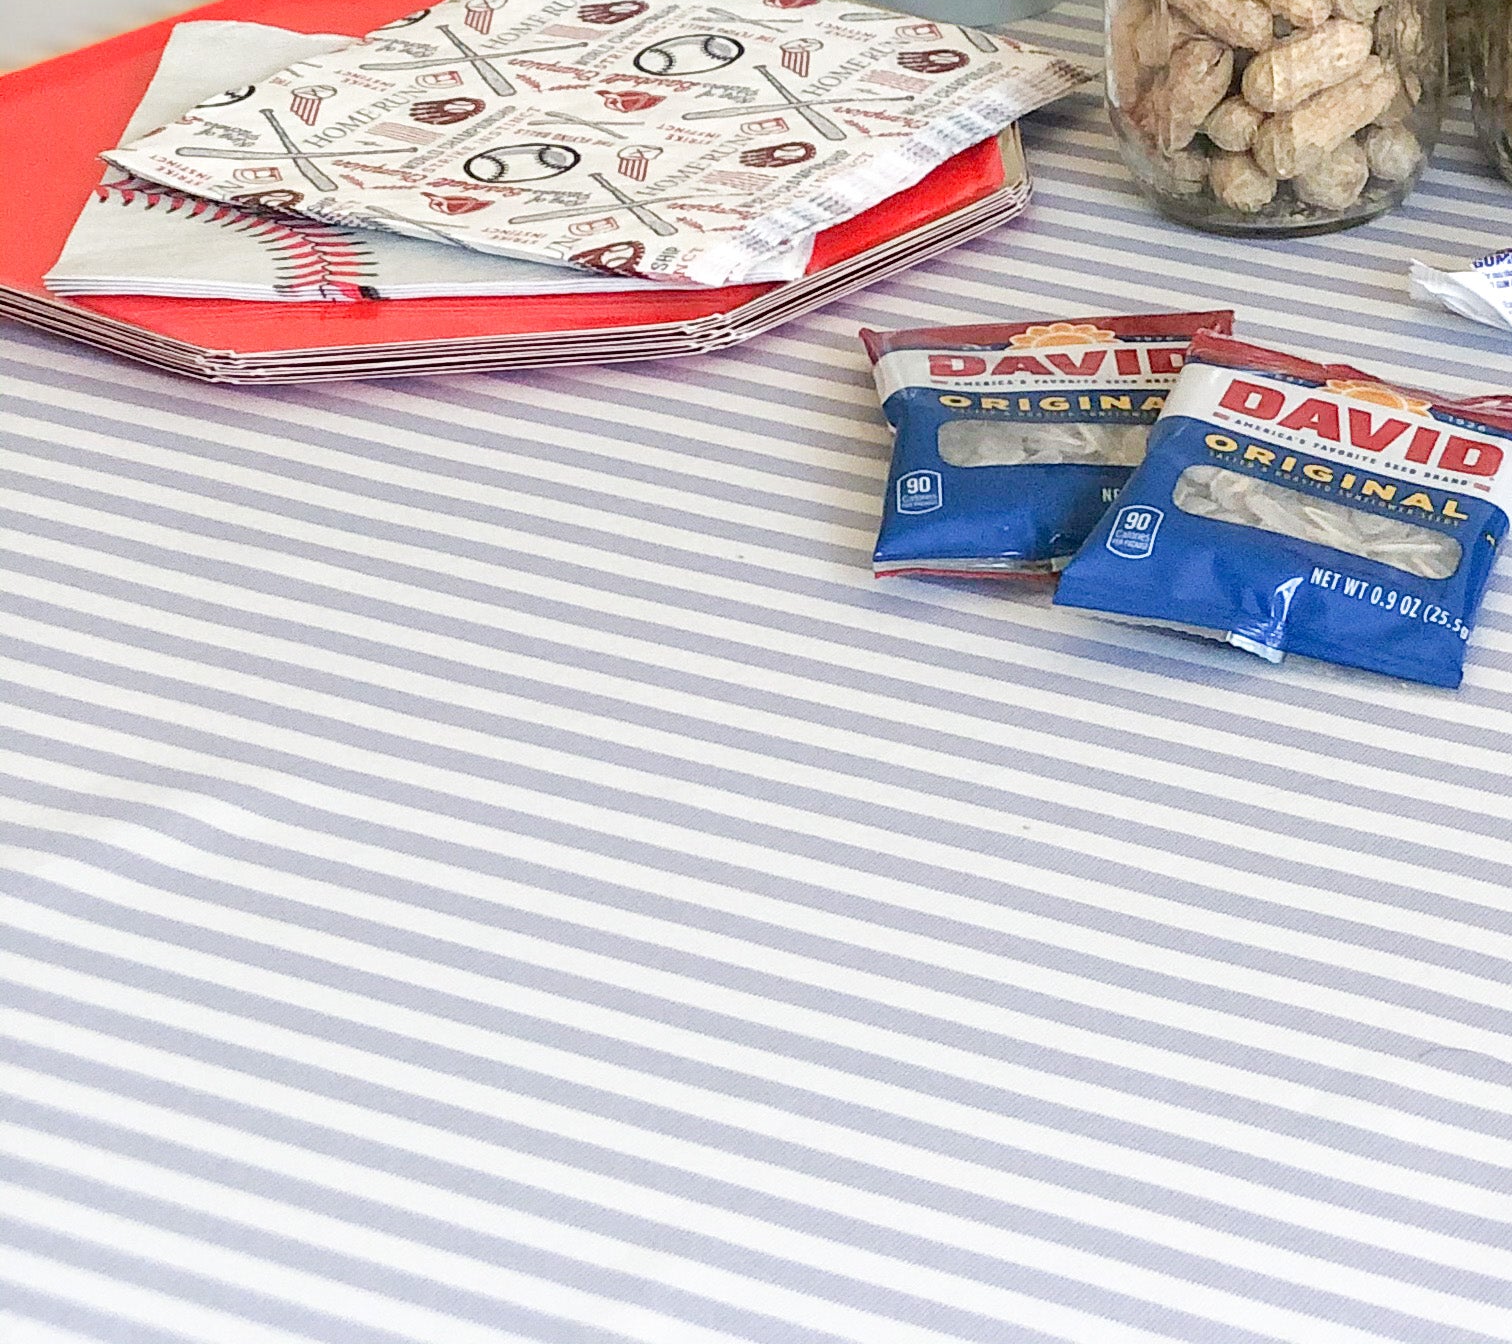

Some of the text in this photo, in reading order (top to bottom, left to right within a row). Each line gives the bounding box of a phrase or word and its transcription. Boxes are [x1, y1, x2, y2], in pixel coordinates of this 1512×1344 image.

[303, 109, 373, 148] HOME
[929, 348, 1188, 377] DAVID
[938, 394, 1166, 411] ORIGINA
[1218, 379, 1504, 477] DAVID
[1235, 419, 1468, 486] AMERICA'S FAVORITE SEED BRAND
[906, 476, 931, 494] 90
[1205, 434, 1469, 521] ORIGINAL
[1123, 512, 1151, 531] 90
[1311, 567, 1470, 640] NET WT 0.9 OZ (25.5g
